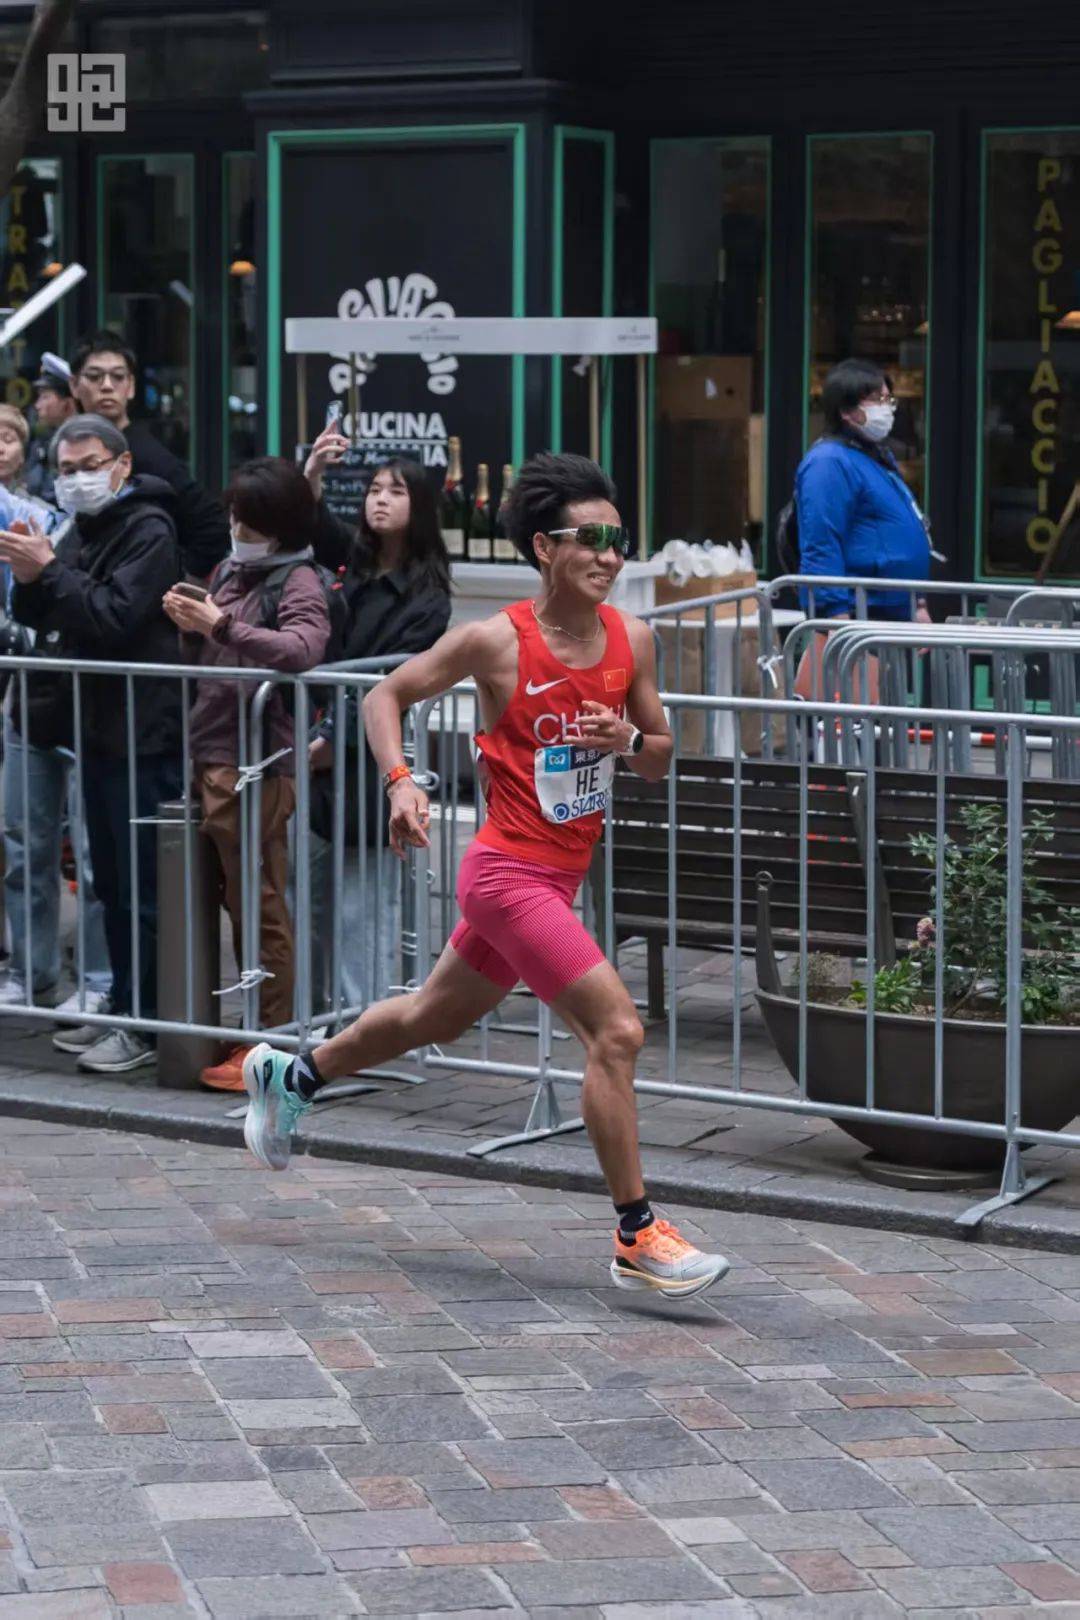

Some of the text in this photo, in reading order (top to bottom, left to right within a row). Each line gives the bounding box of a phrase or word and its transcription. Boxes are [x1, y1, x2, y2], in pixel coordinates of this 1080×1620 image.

[6, 186, 32, 410] TRATO
[1026, 158, 1063, 553] PAGLIACCIO
[343, 411, 448, 438] CUCINA
[576, 766, 599, 797] HE
